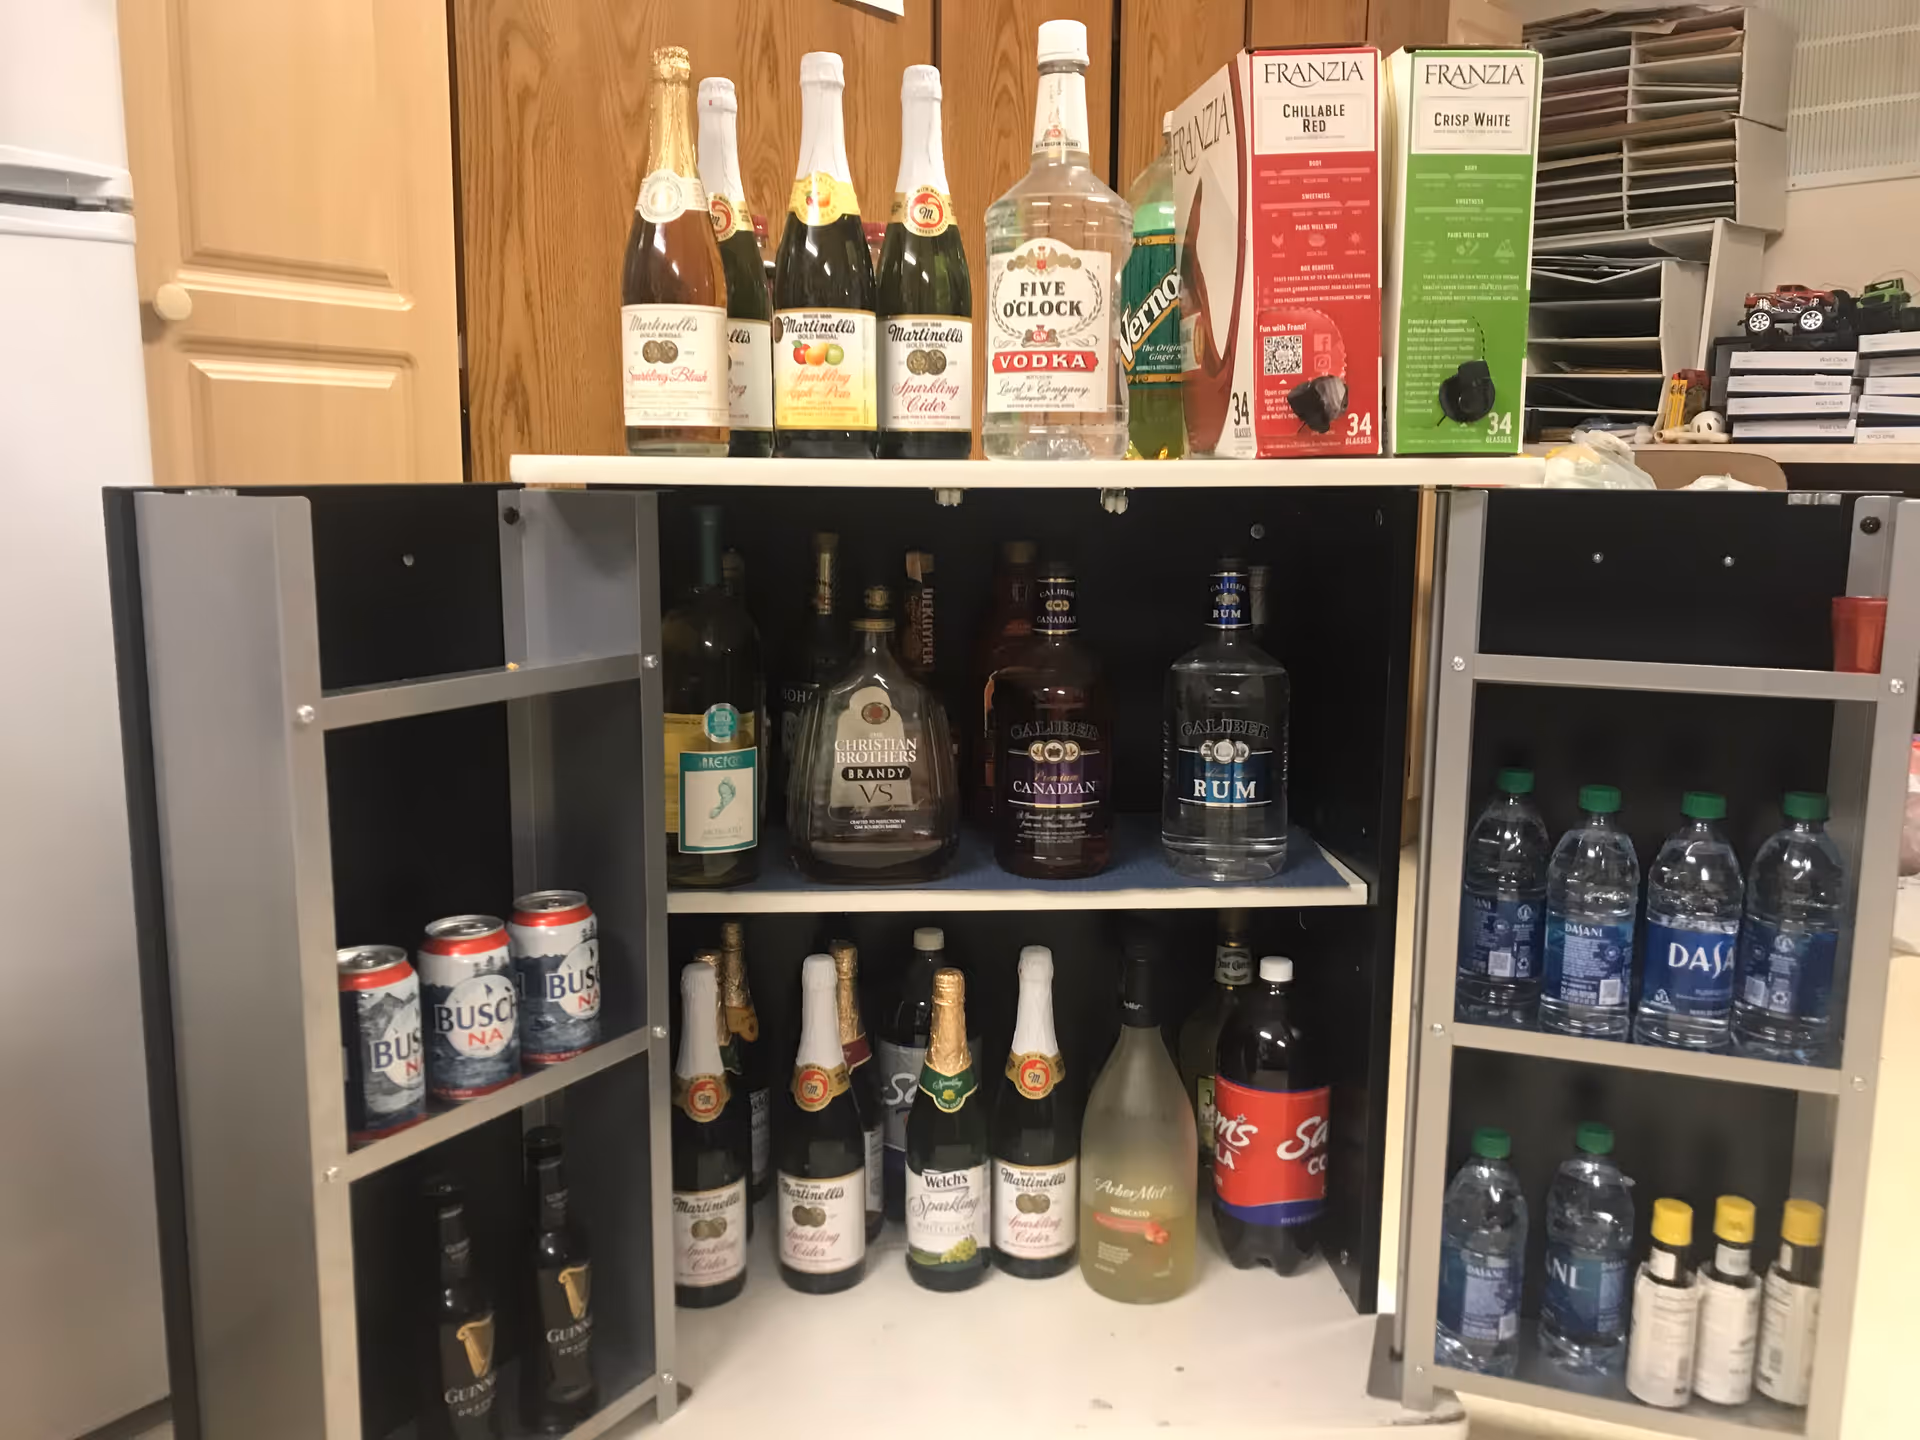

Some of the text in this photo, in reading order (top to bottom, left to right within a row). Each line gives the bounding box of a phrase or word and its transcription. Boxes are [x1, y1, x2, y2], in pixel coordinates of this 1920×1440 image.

[1264, 61, 1365, 88] FRANZIA
[1425, 64, 1525, 90] FRANZIA
[1173, 91, 1231, 176] FRANZIA
[1020, 281, 1066, 297] FIVE
[1003, 299, 1083, 318] O'CLOCK
[1119, 267, 1180, 364] Verno
[1260, 324, 1271, 333] Fun
[1272, 323, 1286, 332] with
[1141, 345, 1155, 353] The
[1148, 353, 1176, 362] Ginger
[999, 353, 1087, 369] VODKA
[891, 378, 960, 400] Sparkling
[902, 397, 947, 414] Cider
[1232, 391, 1250, 426] 34
[1346, 412, 1372, 436] 34
[1487, 411, 1512, 435] 34
[1345, 436, 1372, 446] GLASSES
[1486, 436, 1512, 444] GLASSES
[1210, 582, 1247, 593] CALIBER
[1036, 615, 1077, 624] CANADIAN
[1212, 609, 1242, 618] RUM
[1010, 721, 1100, 740] CALIBER
[1180, 718, 1270, 739] CALIBER
[834, 737, 917, 751] CHRISTIAN
[836, 750, 917, 764] BROTHERS
[848, 768, 905, 779] BRANDY
[858, 783, 893, 804] VS
[1013, 780, 1096, 795] CANADIAN
[1193, 778, 1257, 799] RUM
[1564, 923, 1603, 937] DASANI
[468, 1027, 504, 1048] NA
[406, 1058, 421, 1077] N
[924, 1173, 968, 1189] Welch's
[910, 1191, 980, 1220] Sparkling
